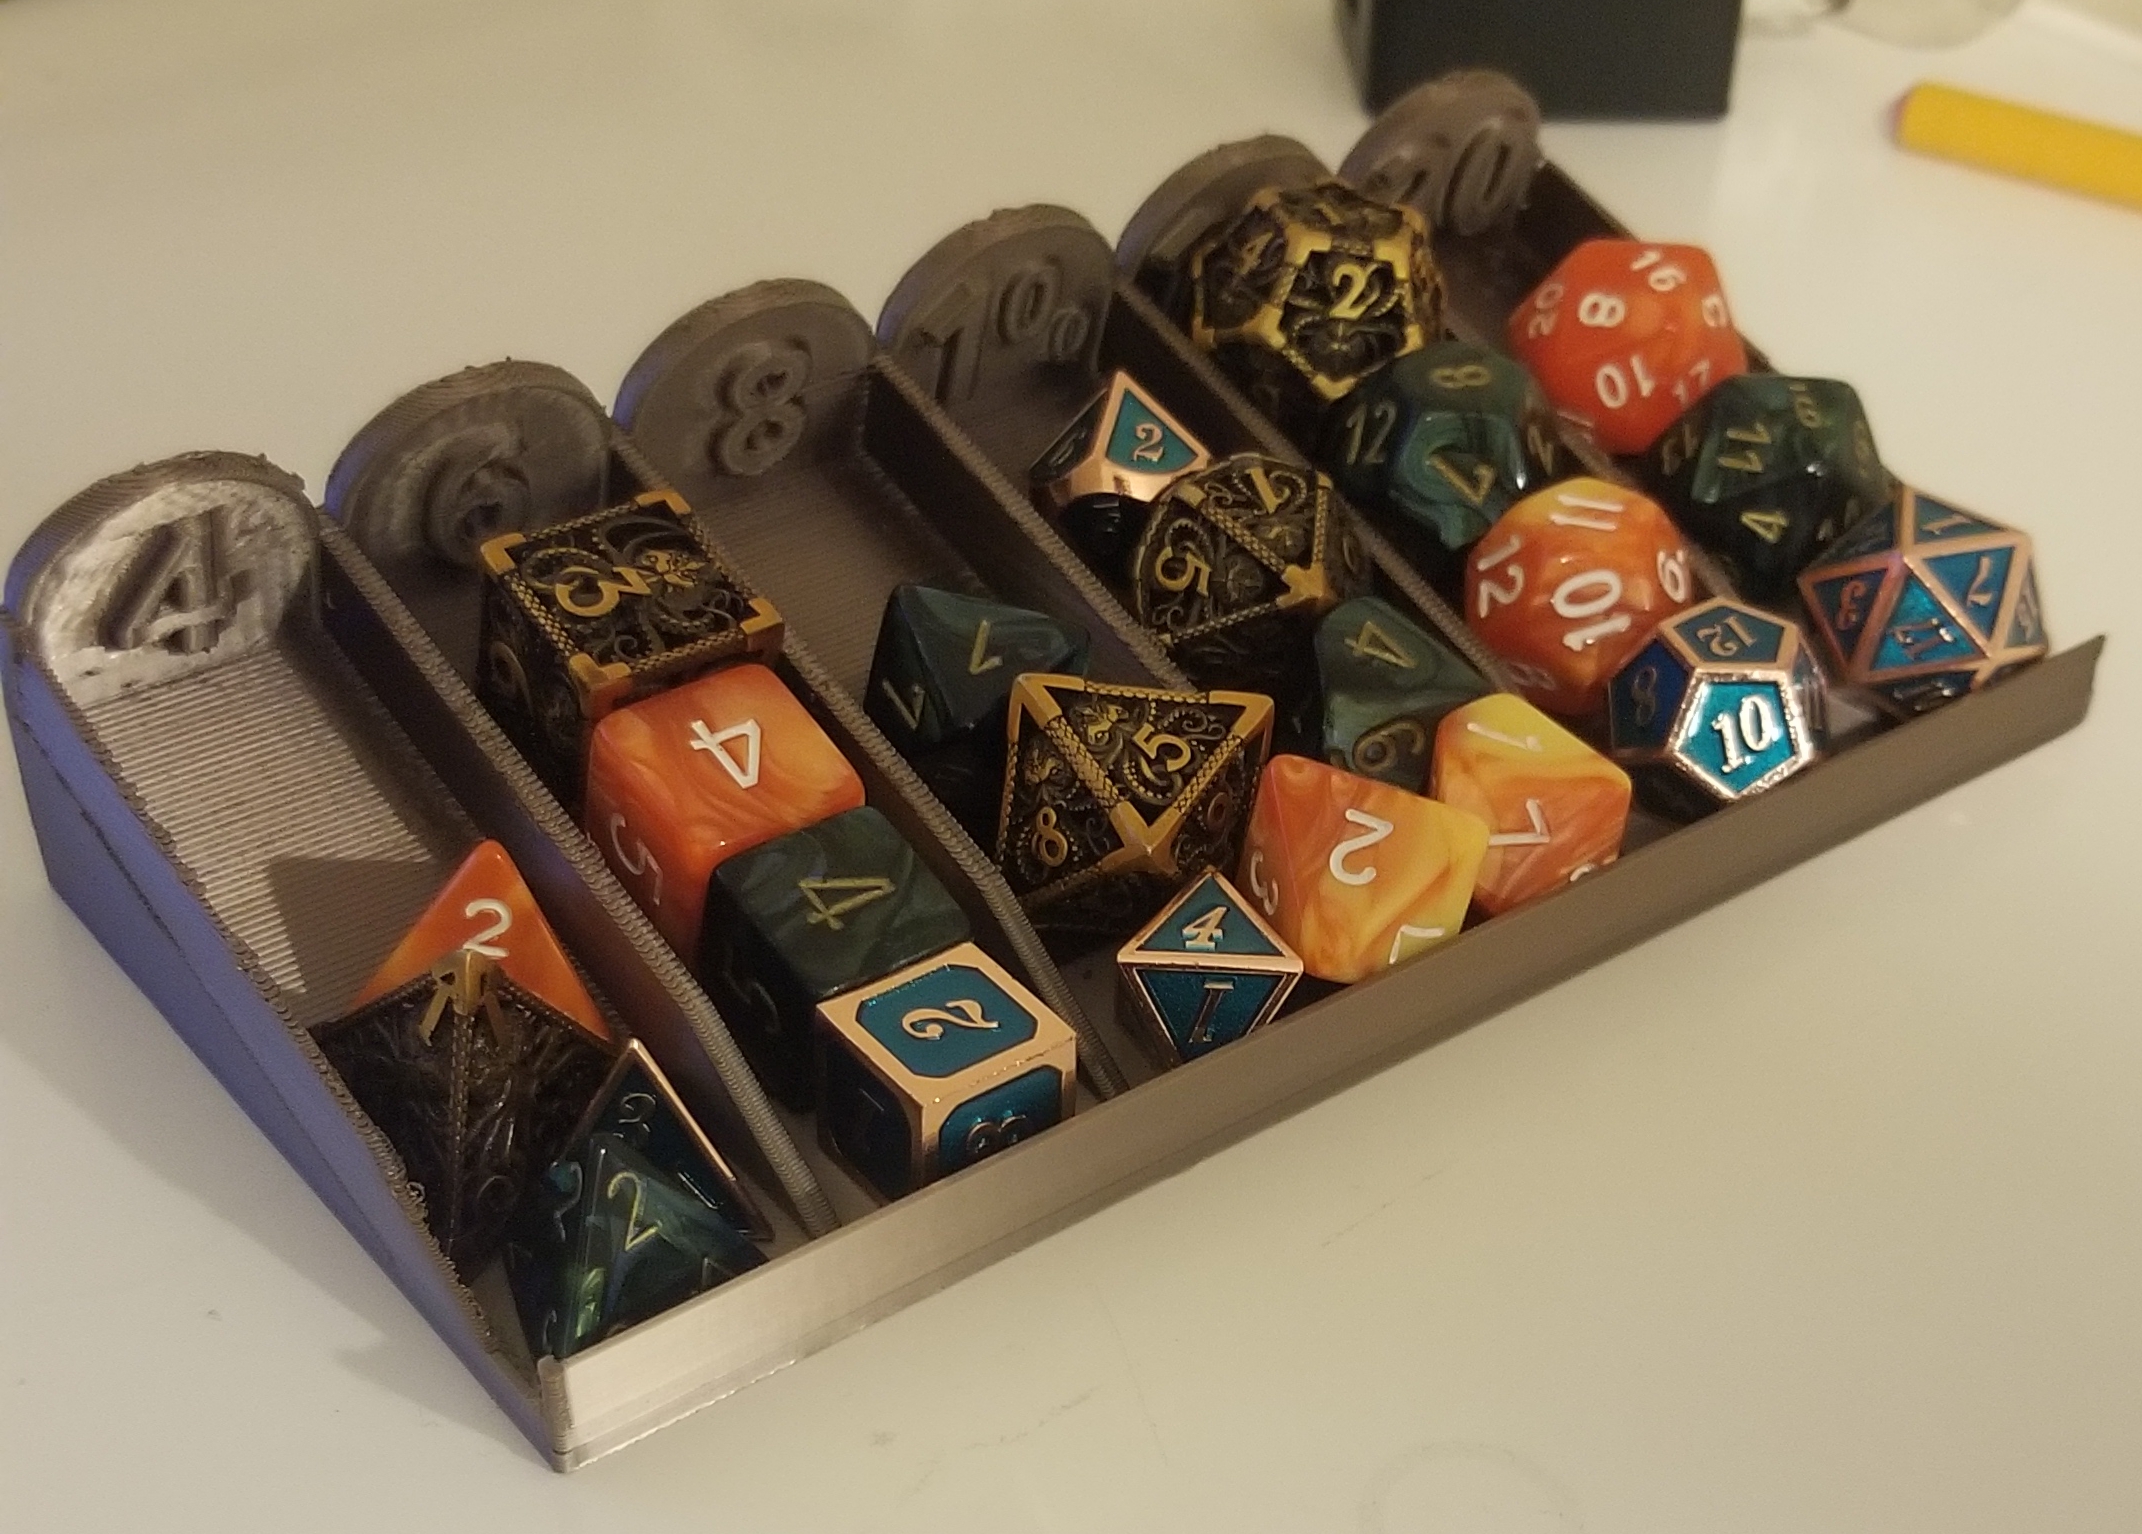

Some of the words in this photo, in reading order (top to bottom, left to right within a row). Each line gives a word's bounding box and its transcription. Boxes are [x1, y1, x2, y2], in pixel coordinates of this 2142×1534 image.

[1329, 262, 1370, 321] 2
[1630, 250, 1688, 292] 16
[1577, 291, 1626, 328] 8
[1429, 364, 1492, 389] 8
[1596, 355, 1654, 409] 10
[708, 338, 812, 476] 8
[1345, 401, 1398, 466] 12
[1133, 422, 1164, 463] 2
[1739, 510, 1789, 545] 4
[95, 503, 252, 656] 4
[555, 566, 652, 618] 3
[1155, 548, 1212, 597] 5
[1476, 534, 1526, 619] 12
[1551, 568, 1633, 652] 10
[1696, 615, 1758, 657] 12
[1343, 620, 1419, 669] 4
[689, 717, 762, 791] 4
[1132, 721, 1192, 773] 5
[1711, 694, 1776, 775] 10
[1034, 805, 1070, 869] 8
[1329, 808, 1395, 886] 2
[462, 897, 514, 959] 2
[798, 876, 897, 931] 4
[1181, 905, 1225, 951] 4
[901, 998, 1000, 1041] 2
[606, 1170, 664, 1251] 2
